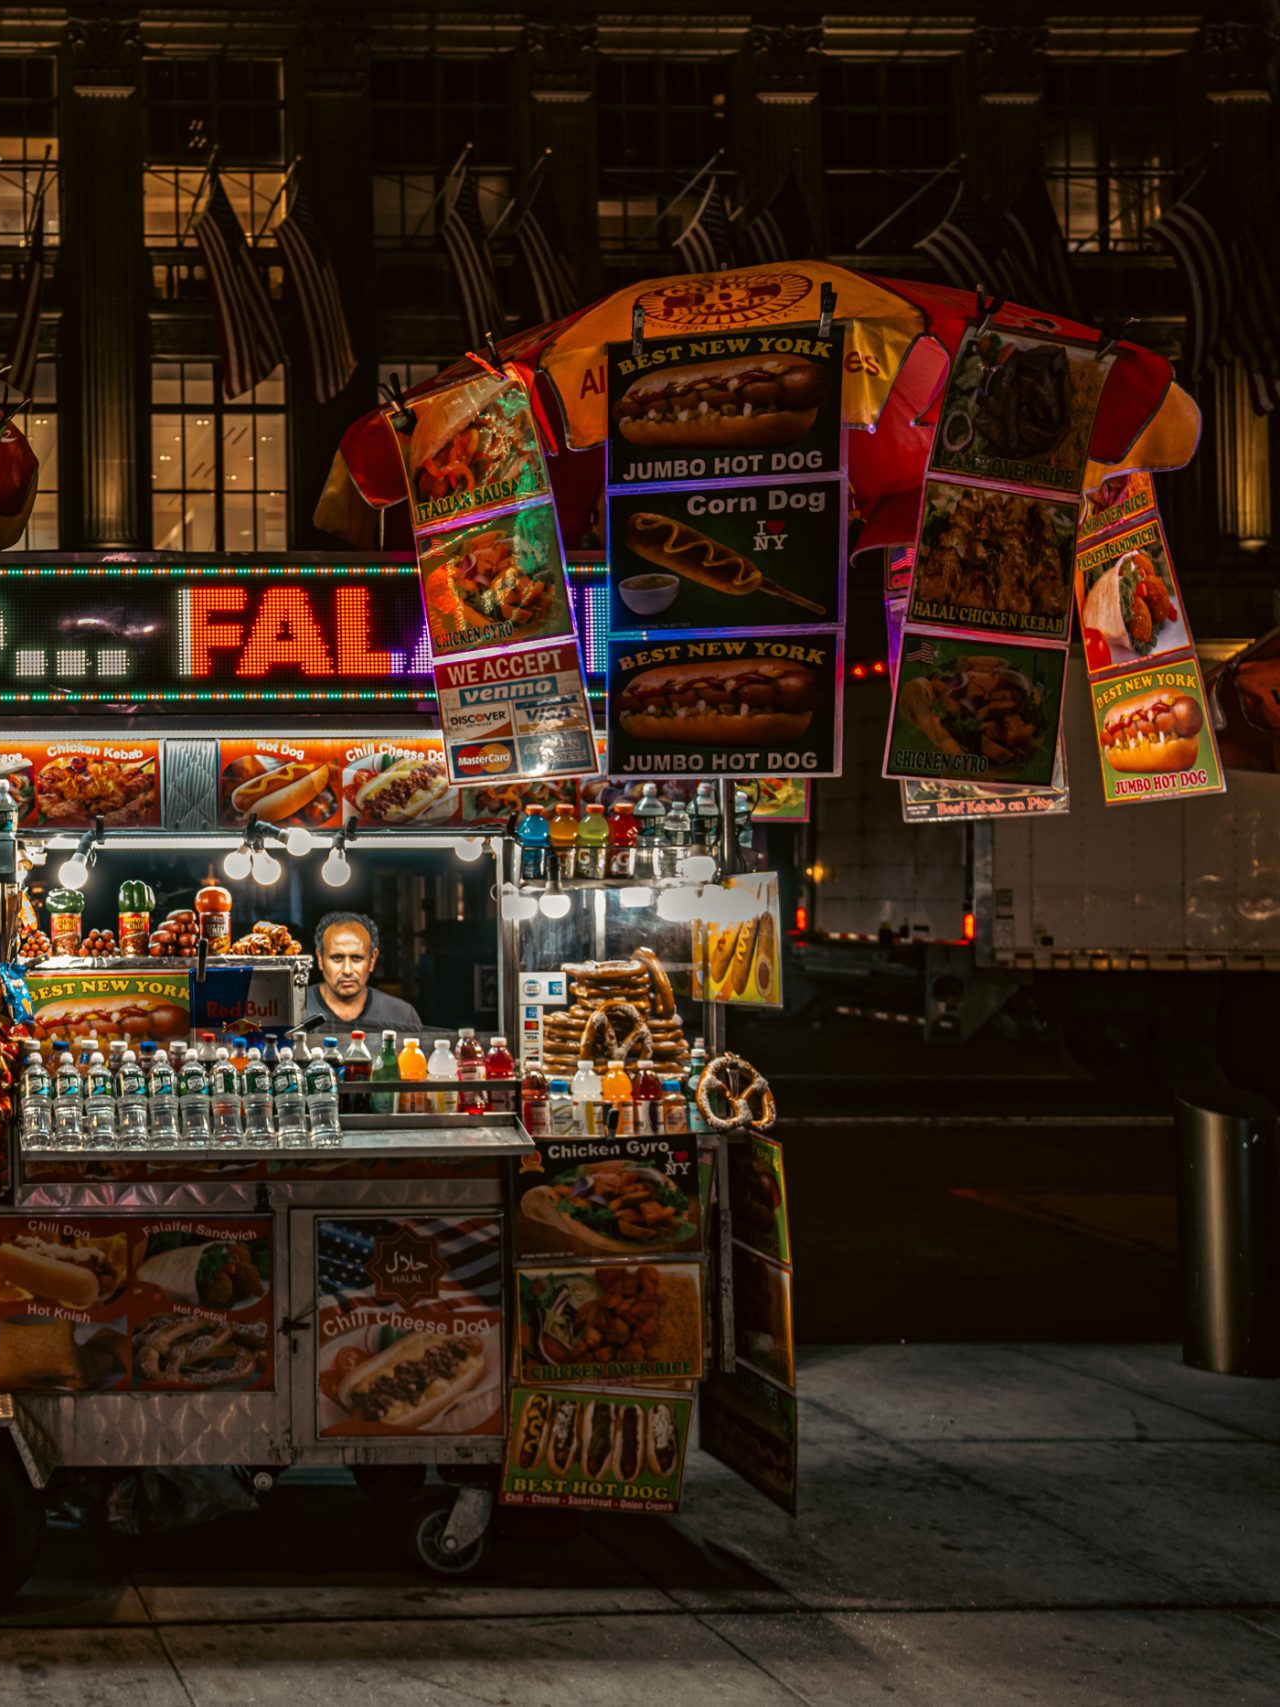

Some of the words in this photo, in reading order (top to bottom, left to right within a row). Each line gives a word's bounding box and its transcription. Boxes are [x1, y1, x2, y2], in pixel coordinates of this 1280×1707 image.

[617, 347, 683, 376] BEST
[690, 338, 751, 358] NEW
[756, 337, 833, 358] YORK
[623, 458, 706, 481] JUMBO
[714, 454, 763, 474] HOT
[771, 450, 823, 471] DOG
[990, 459, 1035, 480] OVER
[1039, 464, 1074, 485] RICE
[417, 491, 472, 522] ITALIAN
[687, 495, 757, 515] Corn
[769, 490, 826, 512] Dog
[1124, 491, 1148, 514] RICE
[757, 521, 766, 536] I
[753, 534, 788, 551] NY
[1108, 526, 1156, 560] SANDWICH
[914, 600, 958, 623] HALAL
[959, 606, 1020, 630] CHICKEN
[1021, 614, 1065, 634] KEBAB
[435, 626, 483, 649] CHICKEN
[483, 620, 513, 641] GYRO
[618, 643, 682, 671] BEST
[688, 642, 747, 657] NEW
[753, 642, 826, 664] YORK
[447, 663, 479, 686] WE
[483, 649, 562, 681] ACCEPT
[463, 679, 552, 703] venmo
[1096, 684, 1123, 711] BEST
[1124, 675, 1154, 693] NEW
[1158, 673, 1198, 689] YORK
[450, 711, 506, 727] DISCOVER
[47, 742, 101, 758] Chicken
[103, 747, 144, 760] Kebab
[256, 740, 279, 754] Hot
[280, 742, 305, 761] Dog
[378, 742, 425, 762] Cheese
[458, 752, 511, 766] MasterCard
[623, 754, 704, 772] JUMBO
[712, 753, 759, 771] HOT
[768, 752, 818, 769] DOG
[895, 750, 952, 771] CHICKEN
[953, 753, 989, 773] GYRO
[1115, 775, 1151, 794] JUMBO
[1153, 774, 1178, 791] HOT
[1180, 771, 1208, 788] DOG
[936, 801, 966, 816] Beef
[966, 798, 1006, 815] Kebab
[1008, 800, 1025, 811] on
[578, 850, 590, 864] G
[29, 981, 76, 1002] BEST
[81, 979, 130, 994] NEW
[135, 981, 190, 1000] YORK
[206, 1000, 241, 1019] Red
[243, 1000, 279, 1018] Bull
[547, 1143, 620, 1160] Chicken
[626, 1140, 669, 1157] Gyro
[667, 1151, 675, 1164] I
[664, 1162, 691, 1176] NY
[28, 1220, 59, 1233] Chili
[63, 1225, 90, 1241] Dog
[195, 1224, 258, 1241] Sandwich
[385, 1251, 429, 1273] حلال
[392, 1274, 423, 1284] HALAL
[27, 1303, 52, 1316] Hot
[54, 1308, 91, 1323] Knish
[173, 1304, 191, 1315] Hot
[194, 1307, 228, 1321] Pretzel
[323, 1311, 368, 1336] Chili
[376, 1311, 448, 1334] Cheese
[453, 1318, 491, 1335] Dog
[531, 1364, 604, 1379] CHICKEN
[607, 1363, 650, 1377] OVER
[655, 1361, 692, 1375] RICE
[513, 1478, 568, 1494] BEST
[573, 1481, 618, 1497] HOT
[623, 1484, 669, 1500] DOG
